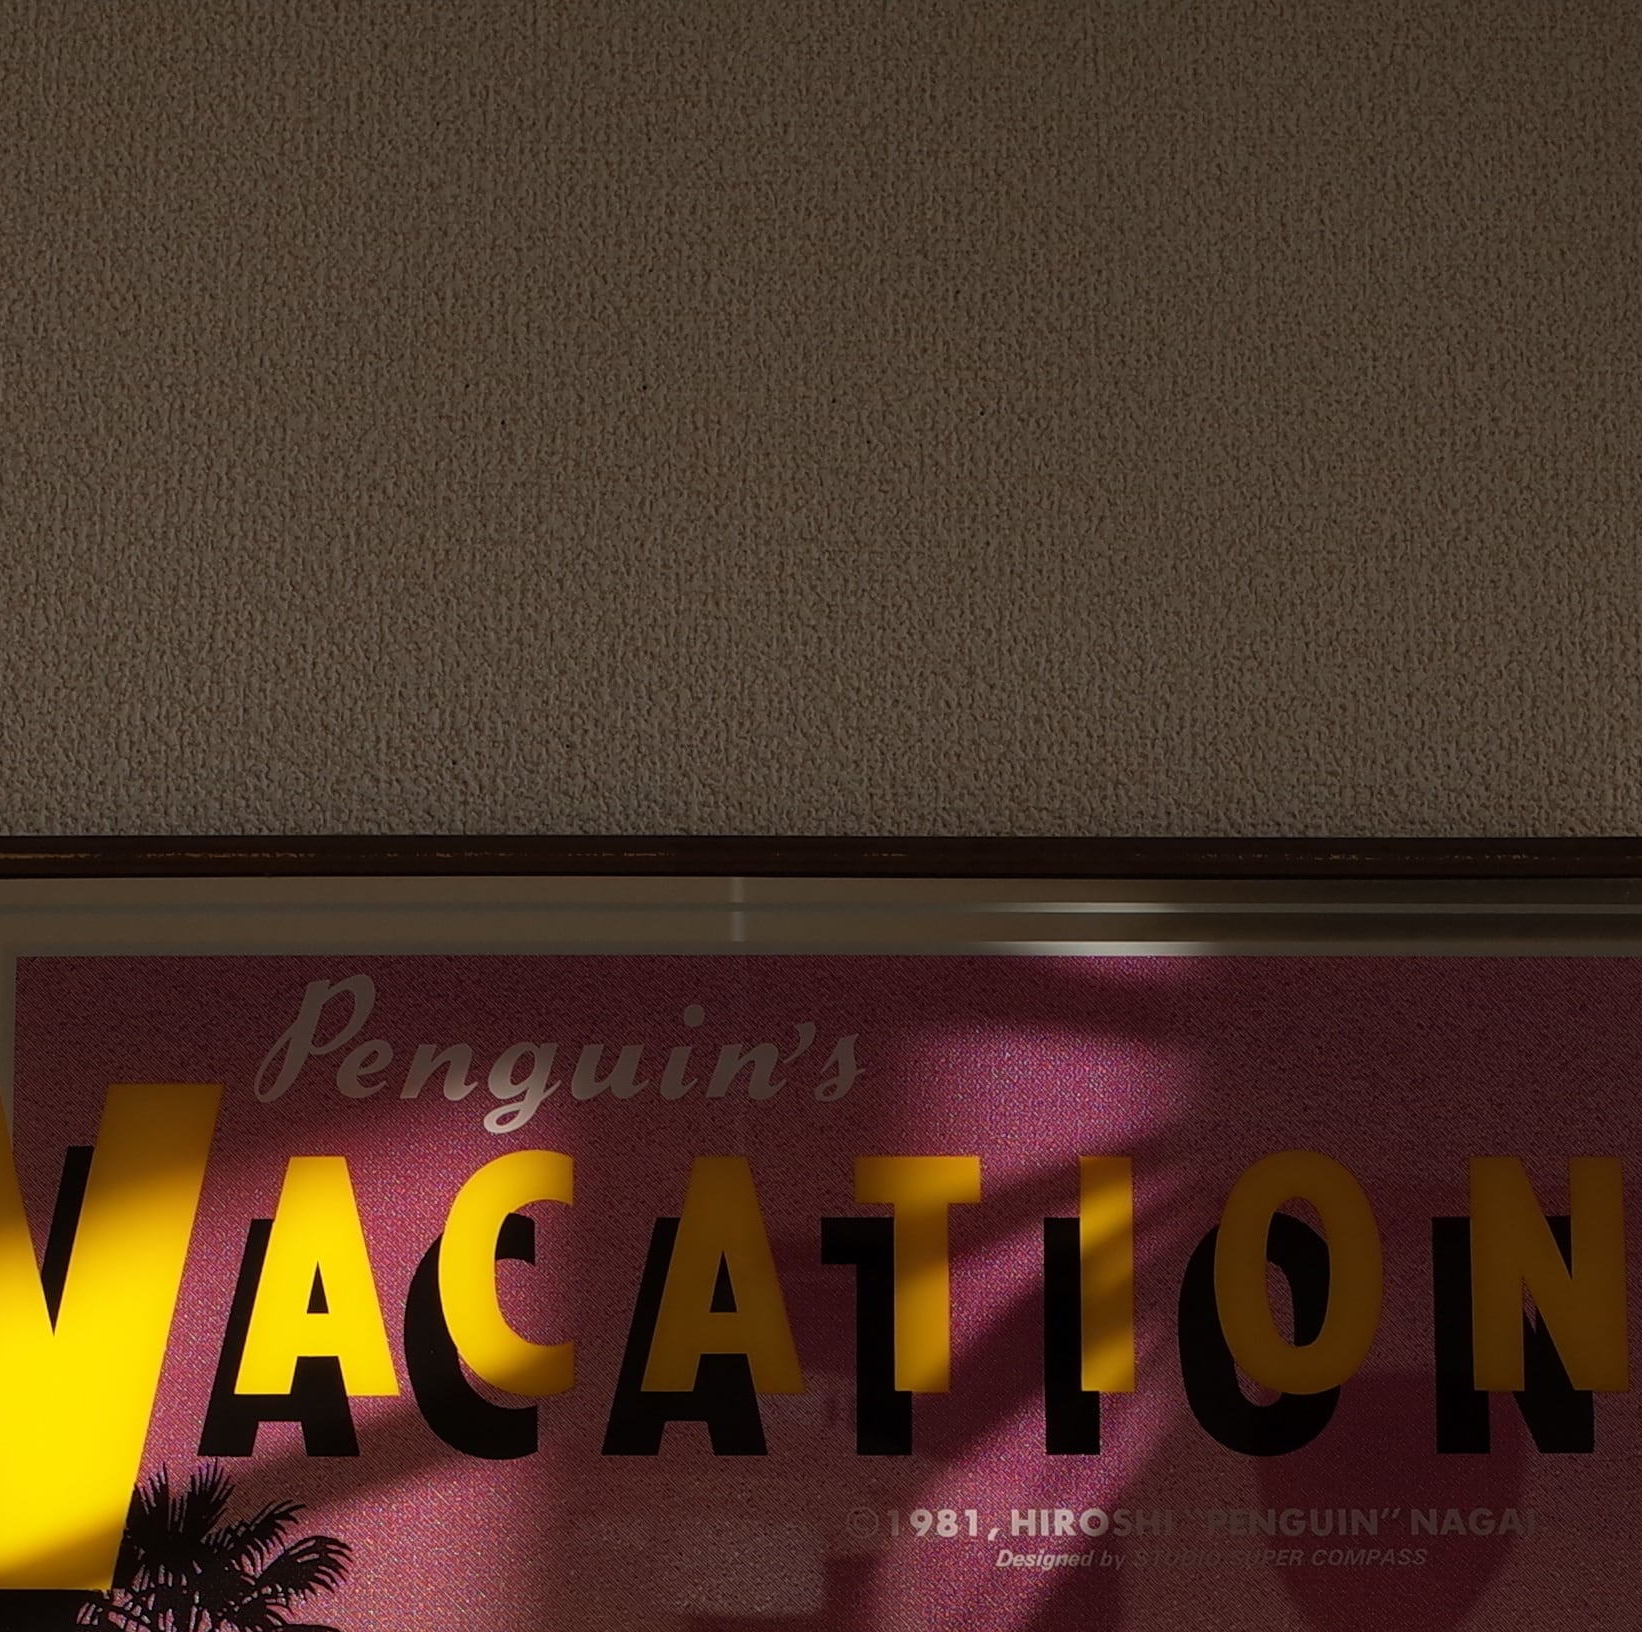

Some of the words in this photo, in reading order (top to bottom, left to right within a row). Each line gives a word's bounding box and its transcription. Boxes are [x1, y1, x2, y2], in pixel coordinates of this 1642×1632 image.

[254, 973, 866, 1134] Penguin's
[1010, 1508, 1177, 1537] HIROSHI
[1410, 1508, 1537, 1536] NAGAI
[995, 1549, 1094, 1571] Designed
[1100, 1549, 1126, 1571] by
[1230, 1549, 1305, 1567] SUPER
[1311, 1549, 1429, 1567] COMPASS
